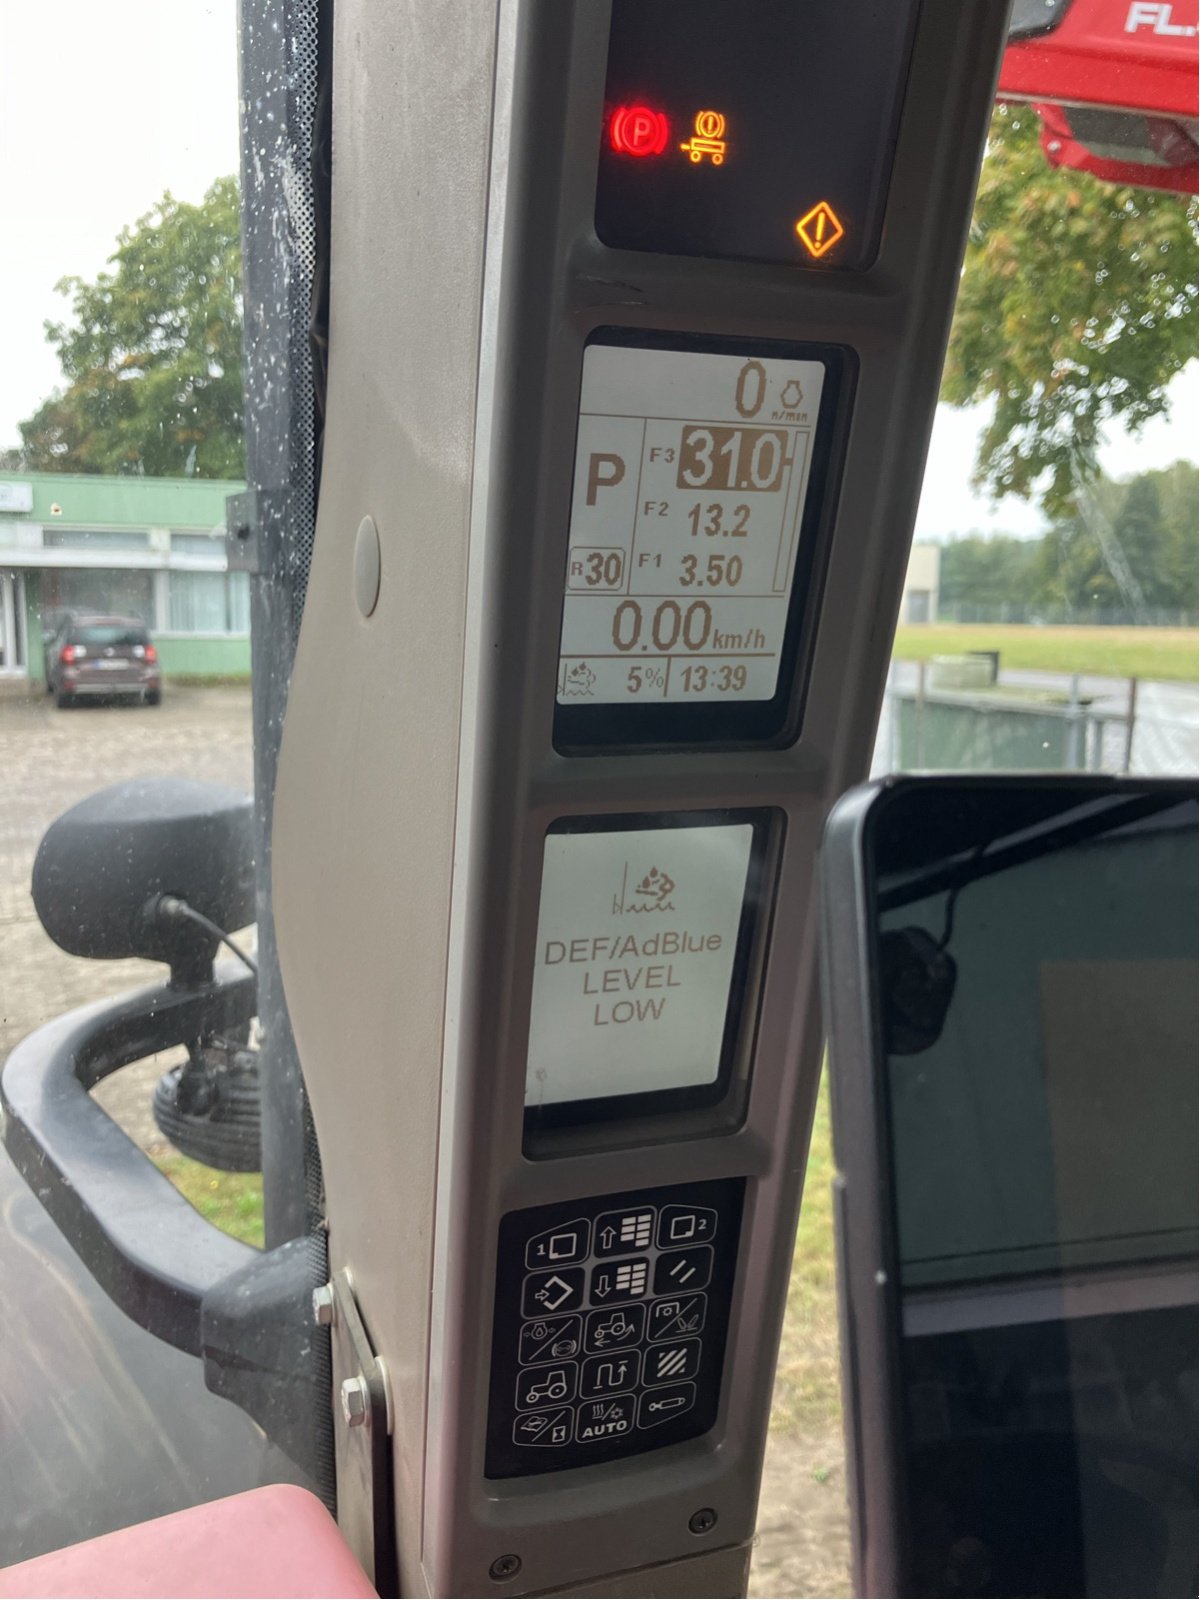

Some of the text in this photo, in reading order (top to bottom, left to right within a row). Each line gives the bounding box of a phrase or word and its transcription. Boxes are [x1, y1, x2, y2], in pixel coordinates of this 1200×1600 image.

[1124, 1, 1199, 37] FL.
[735, 361, 766, 418] 0
[650, 428, 782, 488] F3 31.0
[586, 452, 626, 506] P
[644, 501, 751, 537] F2 13.2
[638, 553, 743, 587] F1 3.50
[611, 600, 766, 651] 0.00 km/h
[680, 664, 748, 692] 13:39
[544, 930, 722, 965] DEF/AdBlue
[583, 964, 681, 994] LEVEL
[594, 998, 666, 1026] LOW
[698, 1219, 707, 1231] 2
[536, 1243, 546, 1256] 1
[582, 1420, 628, 1439] AUTO
